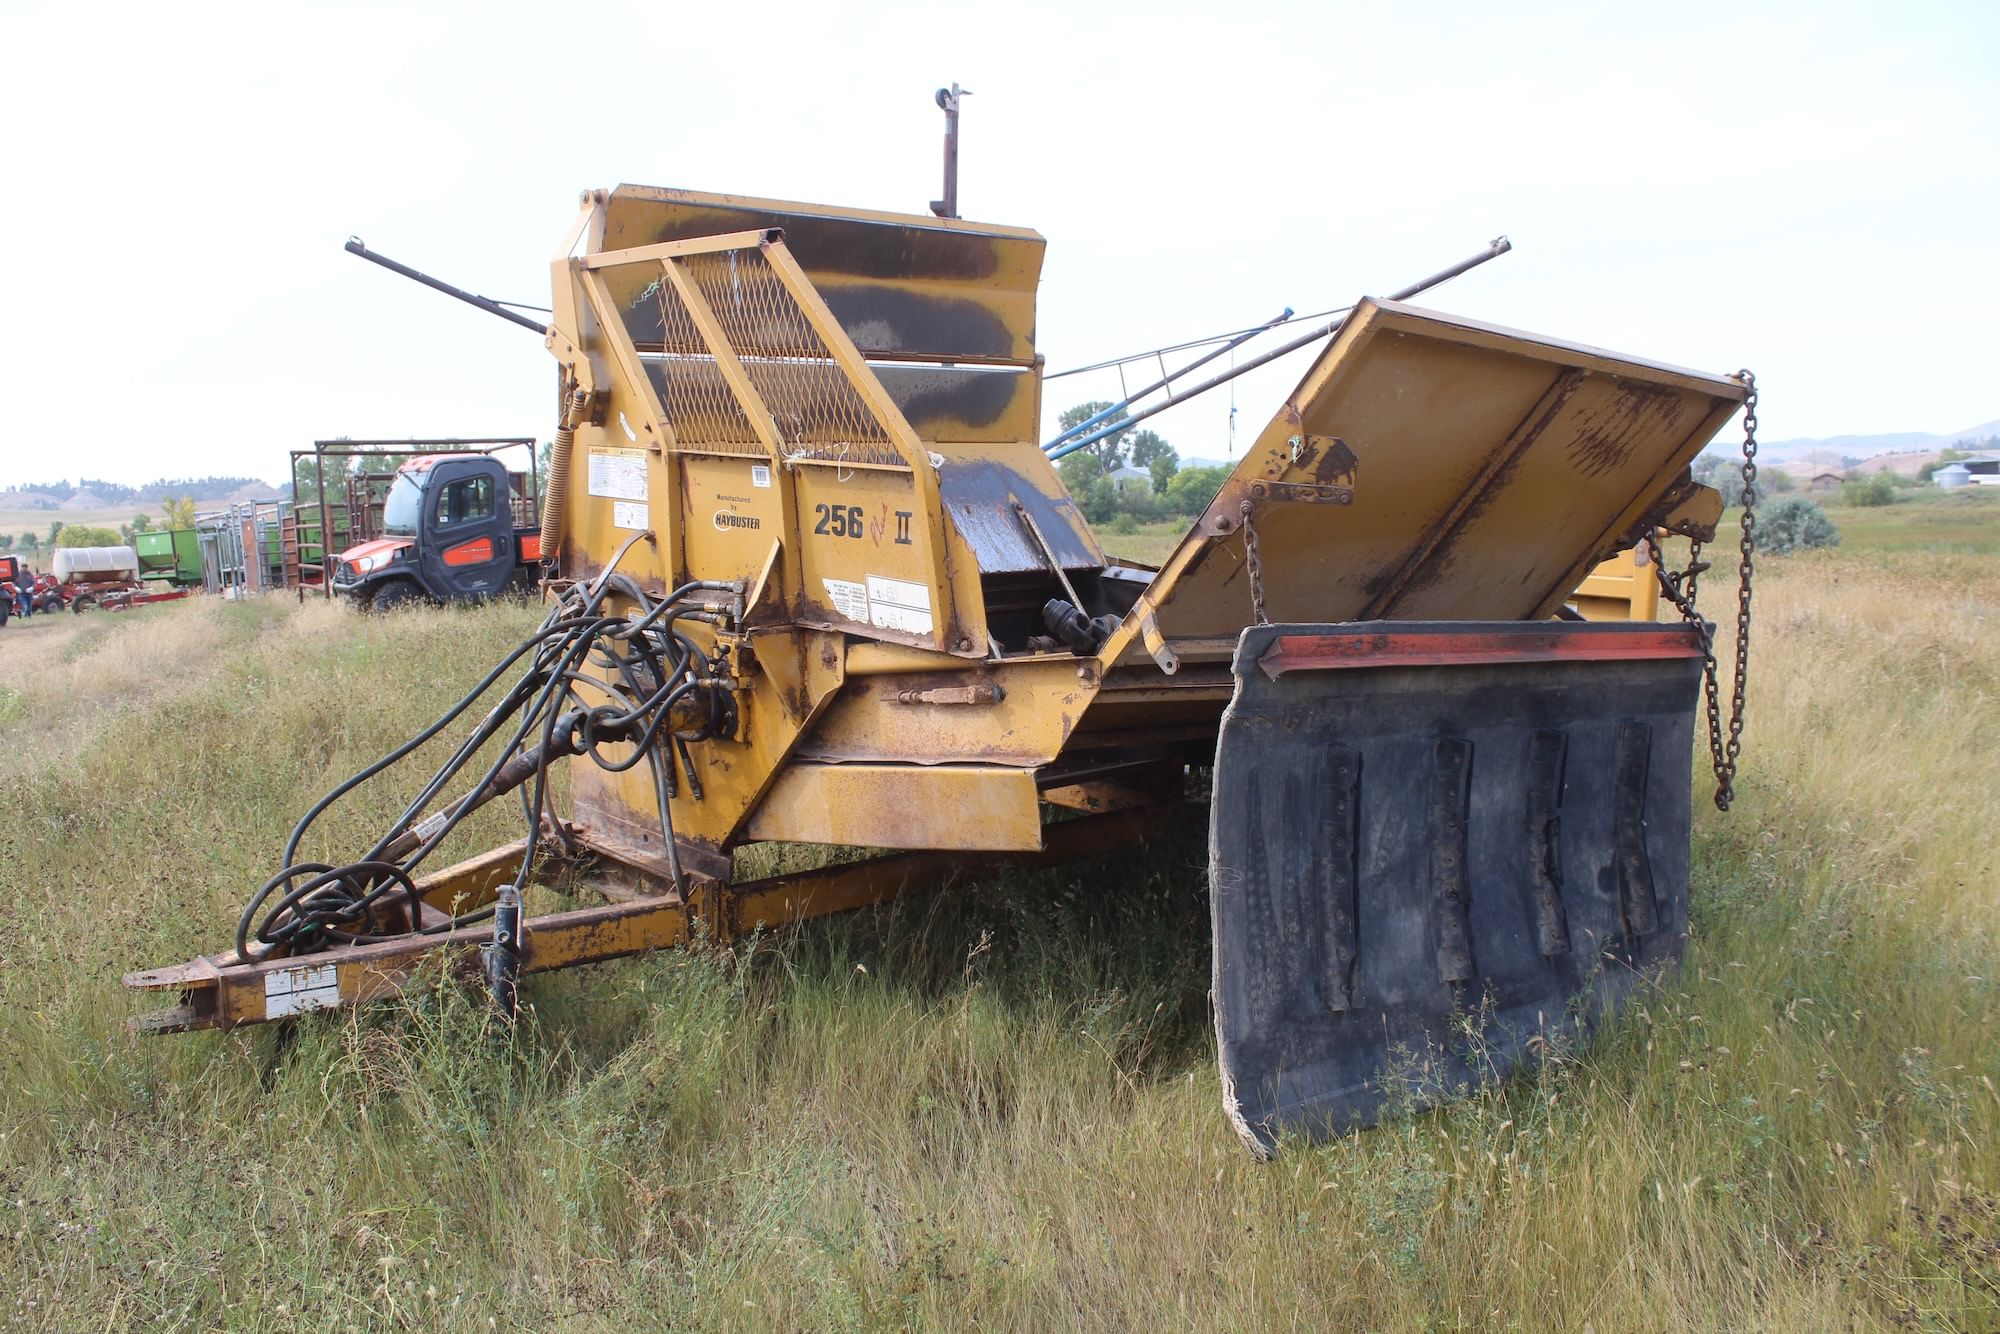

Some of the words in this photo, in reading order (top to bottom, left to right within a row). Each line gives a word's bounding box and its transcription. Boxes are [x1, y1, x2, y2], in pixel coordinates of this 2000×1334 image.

[716, 493, 751, 504] Manufactured
[731, 503, 737, 512] by
[715, 513, 760, 530] HAYBUSTER
[814, 502, 864, 539] 256
[894, 510, 913, 546] II
